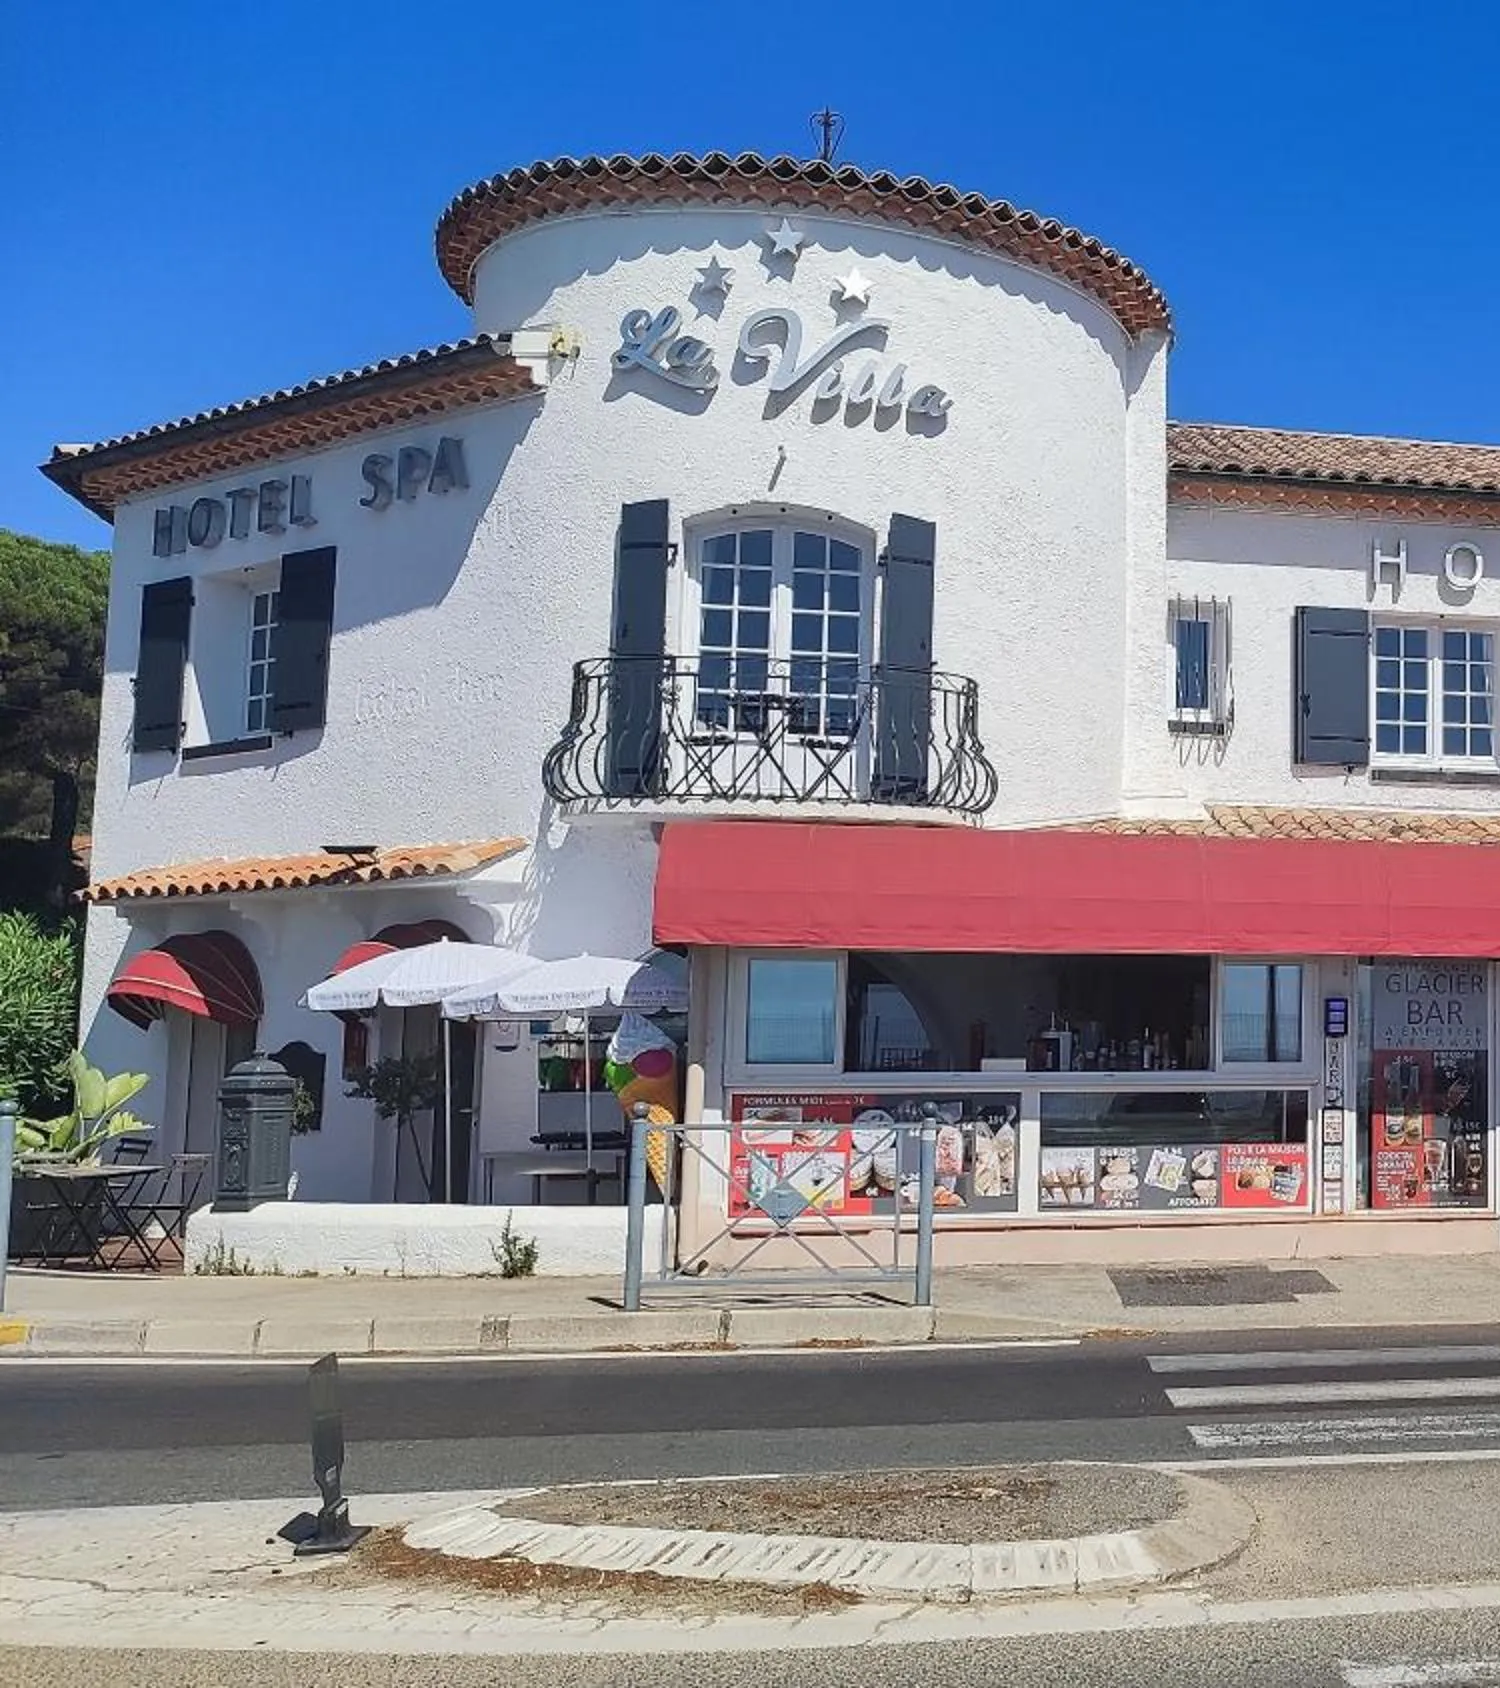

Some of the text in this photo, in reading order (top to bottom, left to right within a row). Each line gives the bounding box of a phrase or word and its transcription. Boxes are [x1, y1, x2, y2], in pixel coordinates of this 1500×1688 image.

[610, 305, 954, 417] La Villa
[153, 436, 470, 557] HOTEL SPA
[1385, 974, 1484, 993] GLACIER
[1407, 1000, 1463, 1025] BAR
